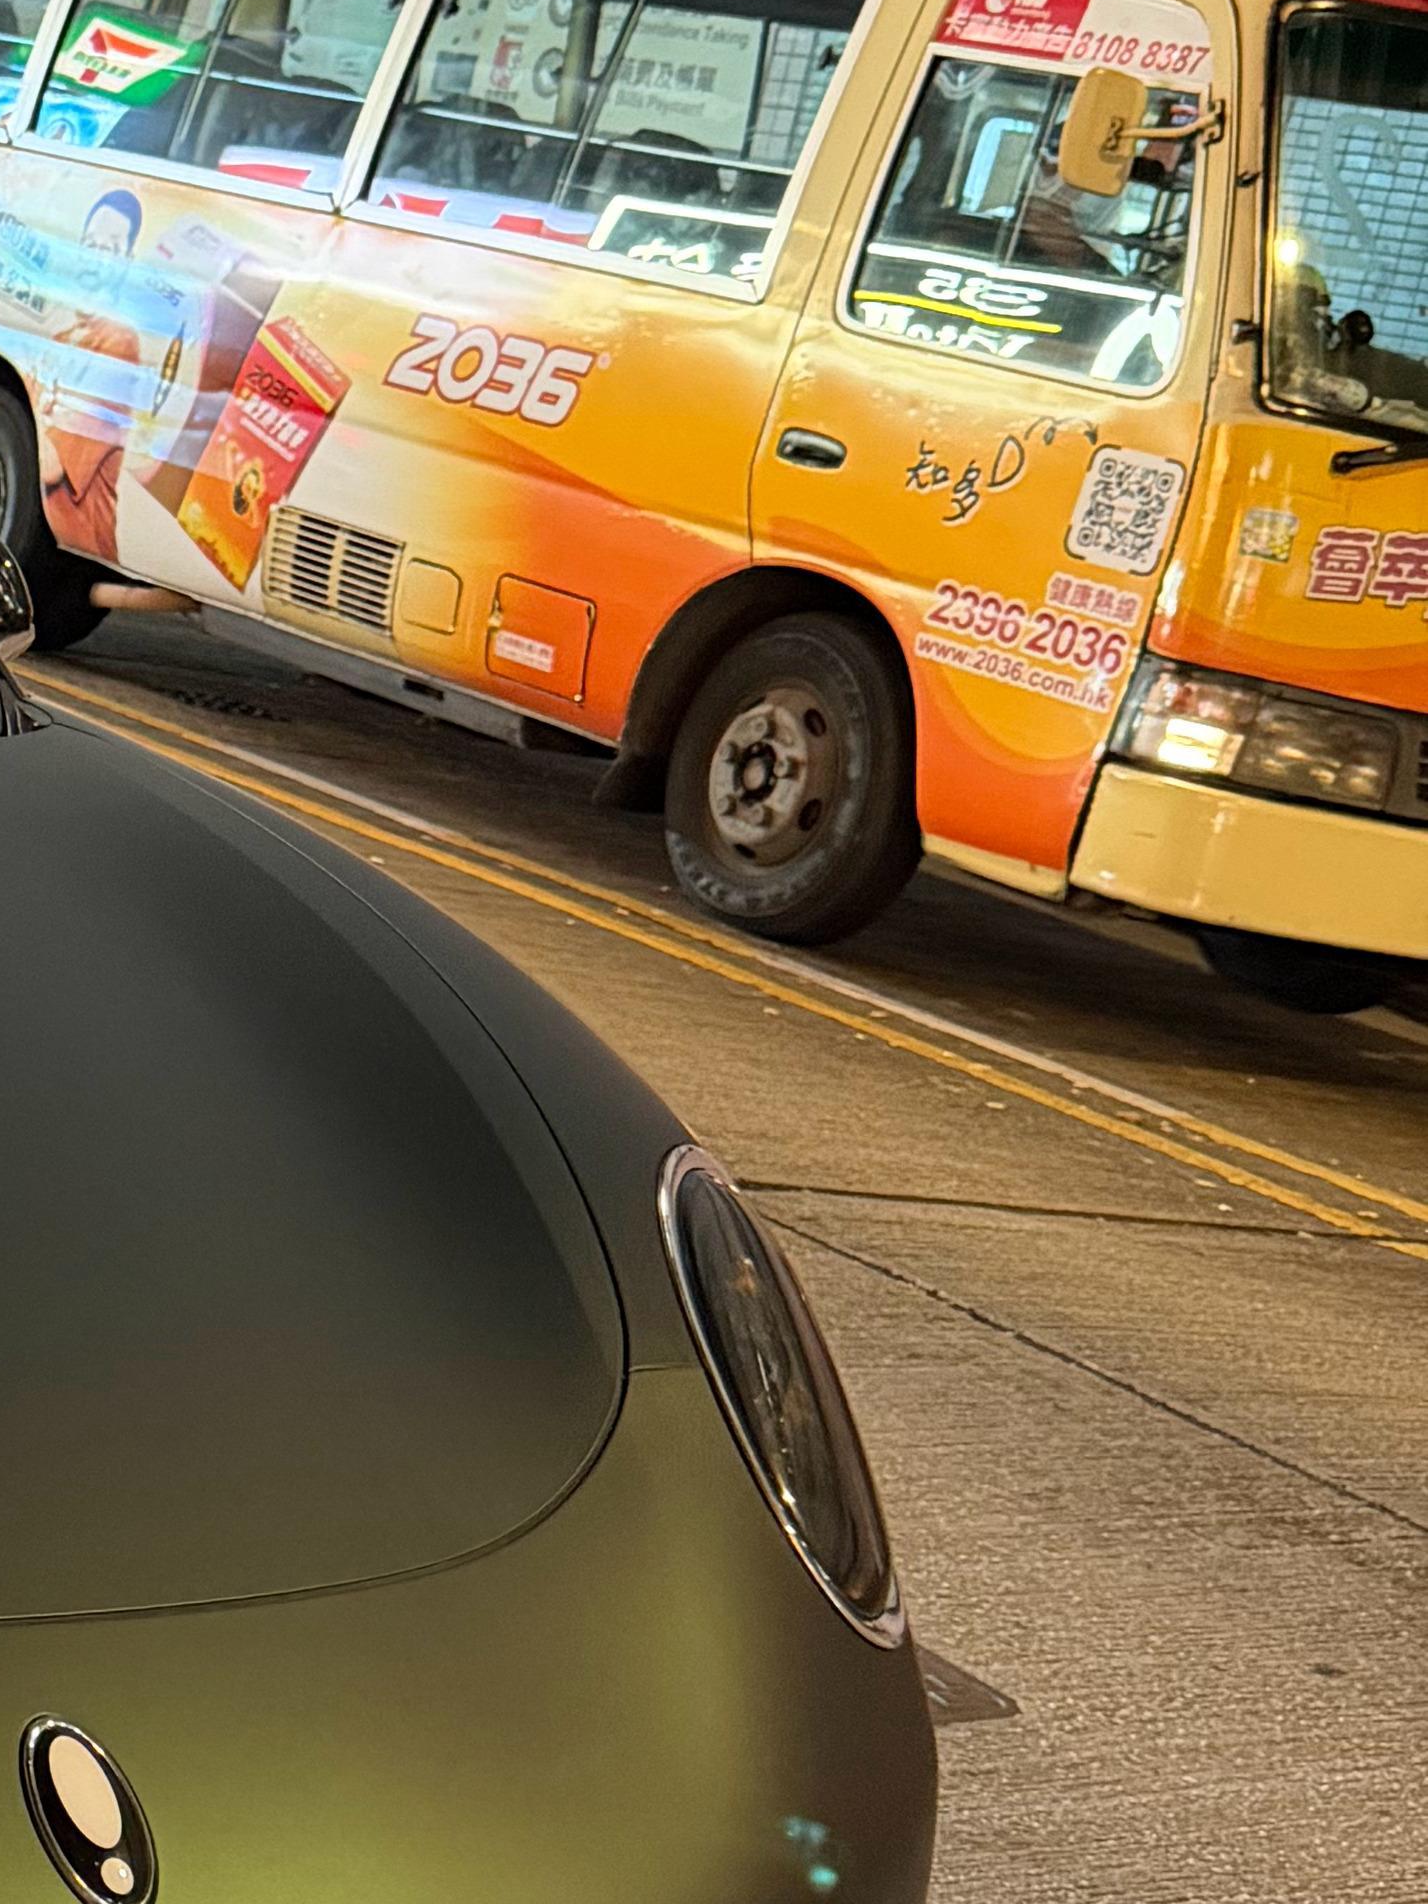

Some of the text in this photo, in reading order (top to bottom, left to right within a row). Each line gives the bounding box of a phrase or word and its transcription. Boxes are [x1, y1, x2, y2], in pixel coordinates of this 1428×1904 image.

[1072, 31, 1211, 76] 8108 8387
[244, 363, 299, 409] 2036
[383, 312, 595, 428] 2036
[928, 584, 1128, 675] 2396 2036
[917, 636, 1111, 710] www.2036.com.hk
